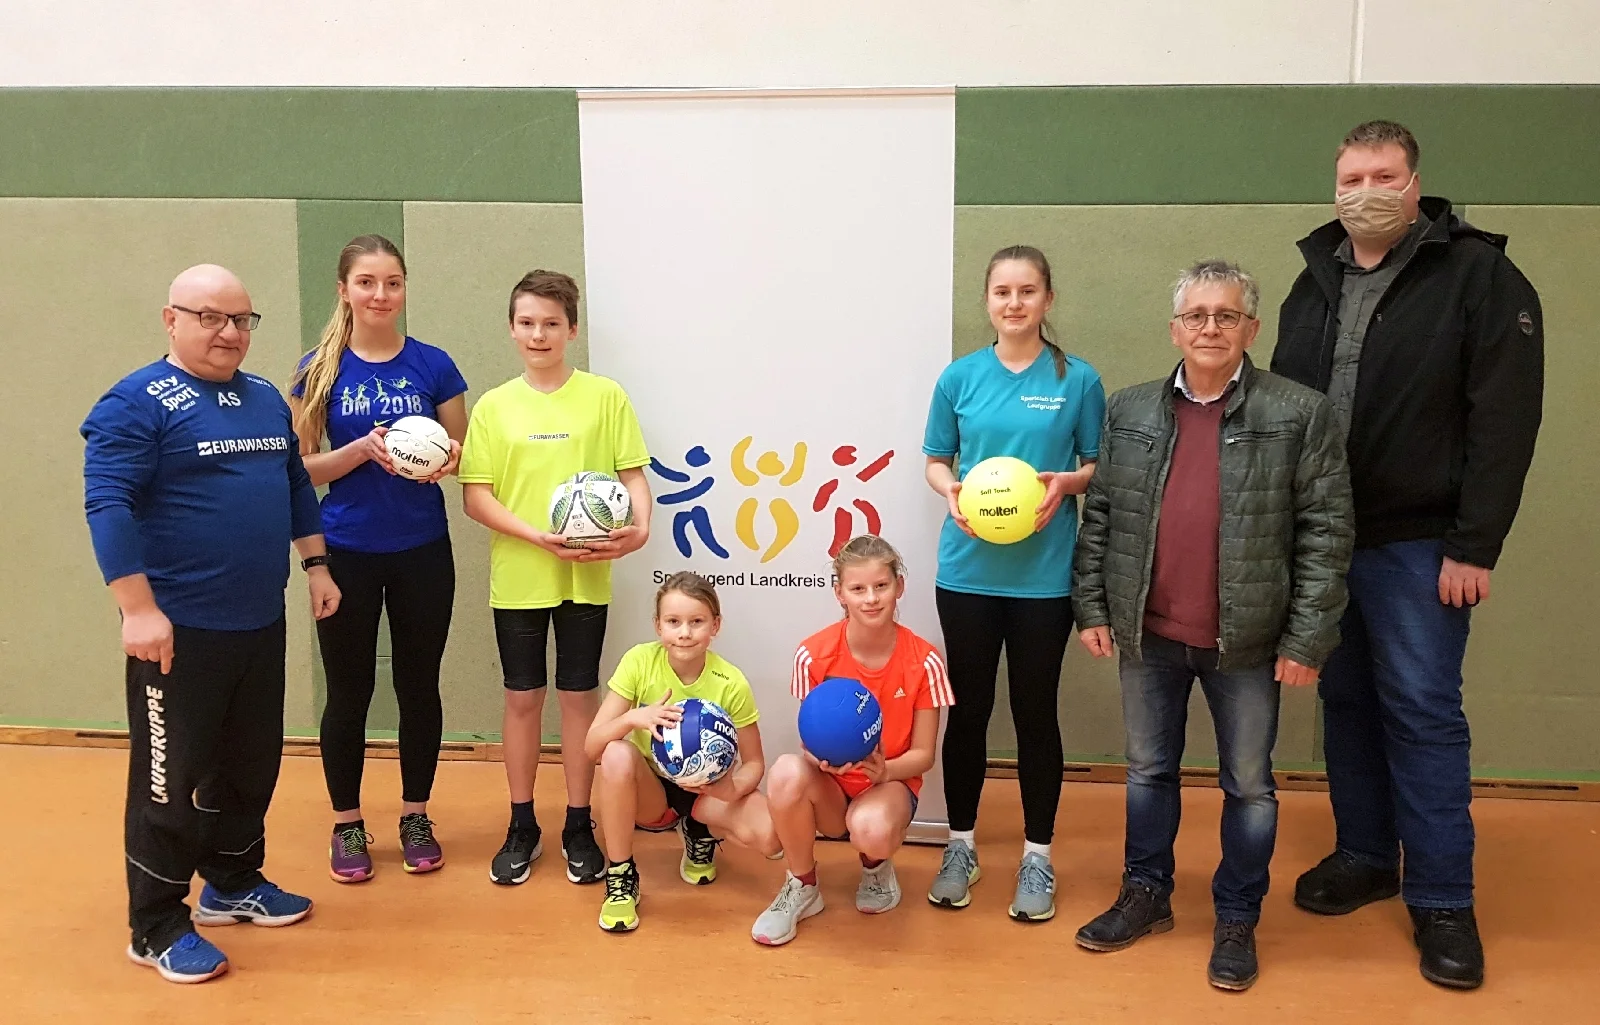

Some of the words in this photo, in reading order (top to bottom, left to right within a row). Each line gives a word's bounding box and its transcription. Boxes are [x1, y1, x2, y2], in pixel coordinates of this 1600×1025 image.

[217, 391, 241, 407] AS
[341, 397, 371, 416] DM
[380, 394, 423, 415] 2018
[213, 437, 288, 454] EURAWASSER
[391, 446, 430, 467] molten
[979, 505, 1018, 517] molten
[750, 572, 826, 588] Landkreis
[145, 684, 169, 804] LAUFGRUPPE
